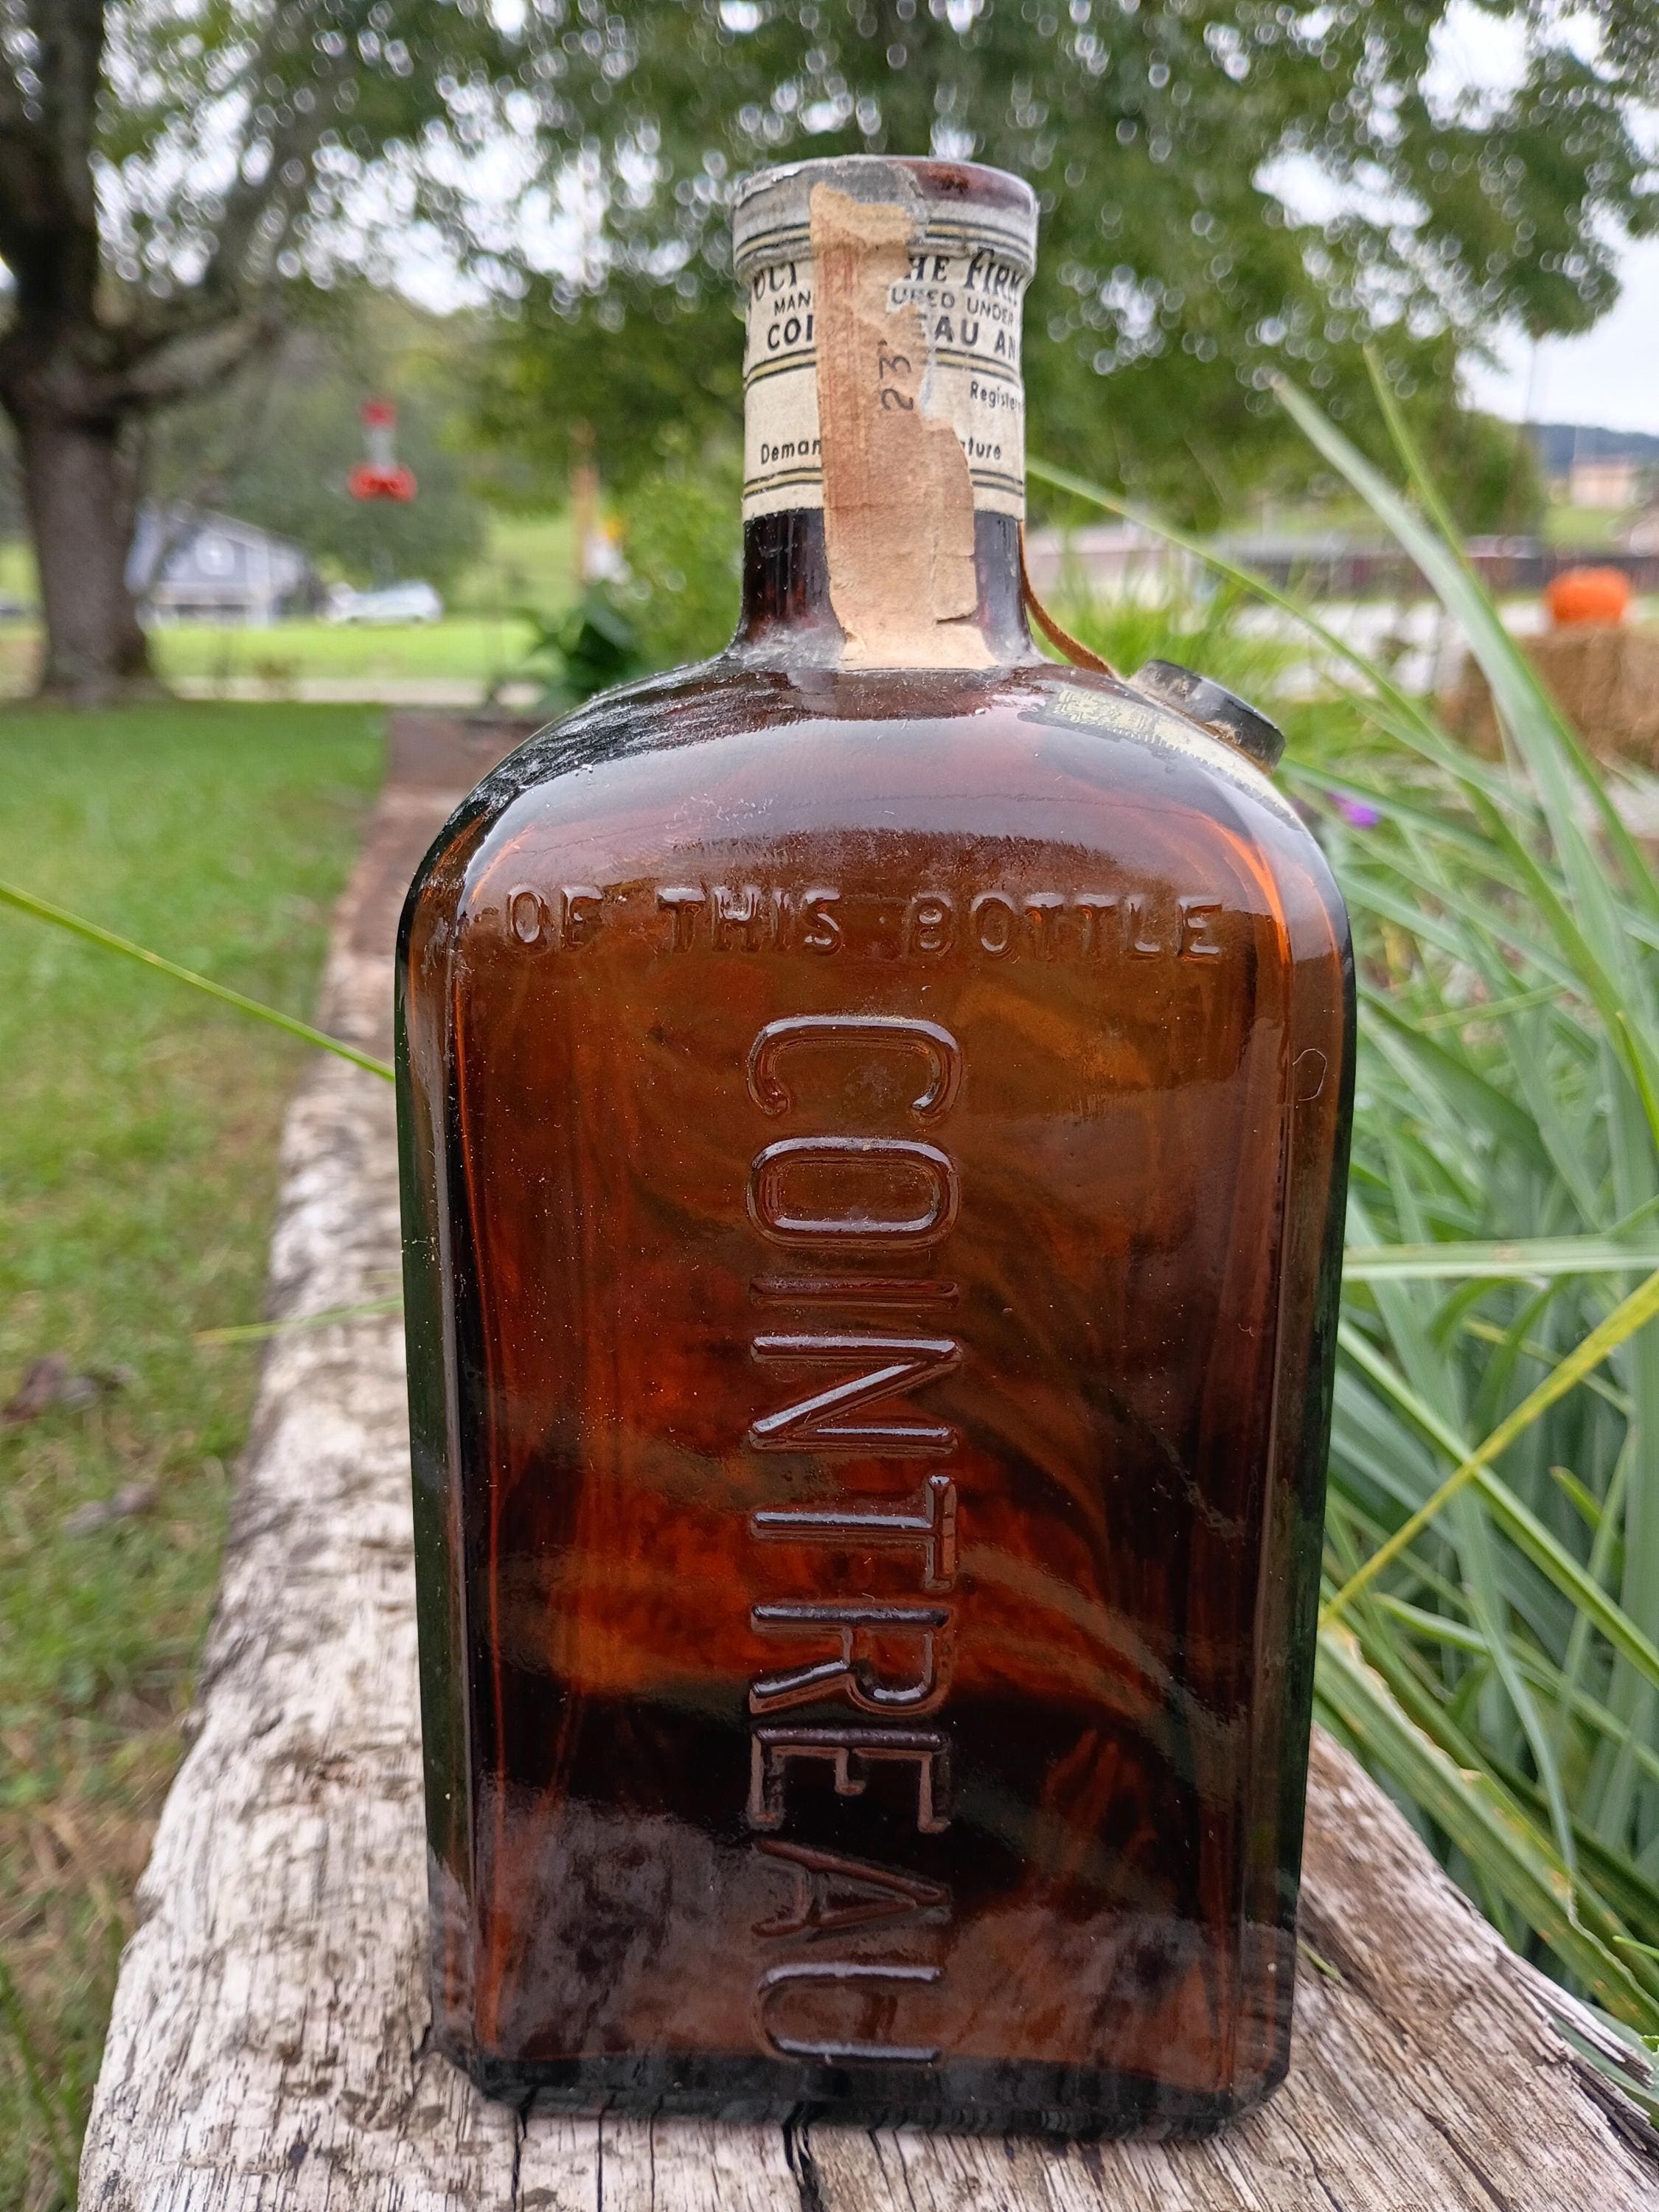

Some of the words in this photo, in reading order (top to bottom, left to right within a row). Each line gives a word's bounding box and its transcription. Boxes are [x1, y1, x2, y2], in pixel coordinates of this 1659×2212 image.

[967, 296, 1014, 326] UNDER
[506, 886, 603, 957] OF
[658, 886, 844, 957] THIS
[911, 889, 1222, 964] BOTTLE
[746, 1013, 962, 2063] COINTREAU
